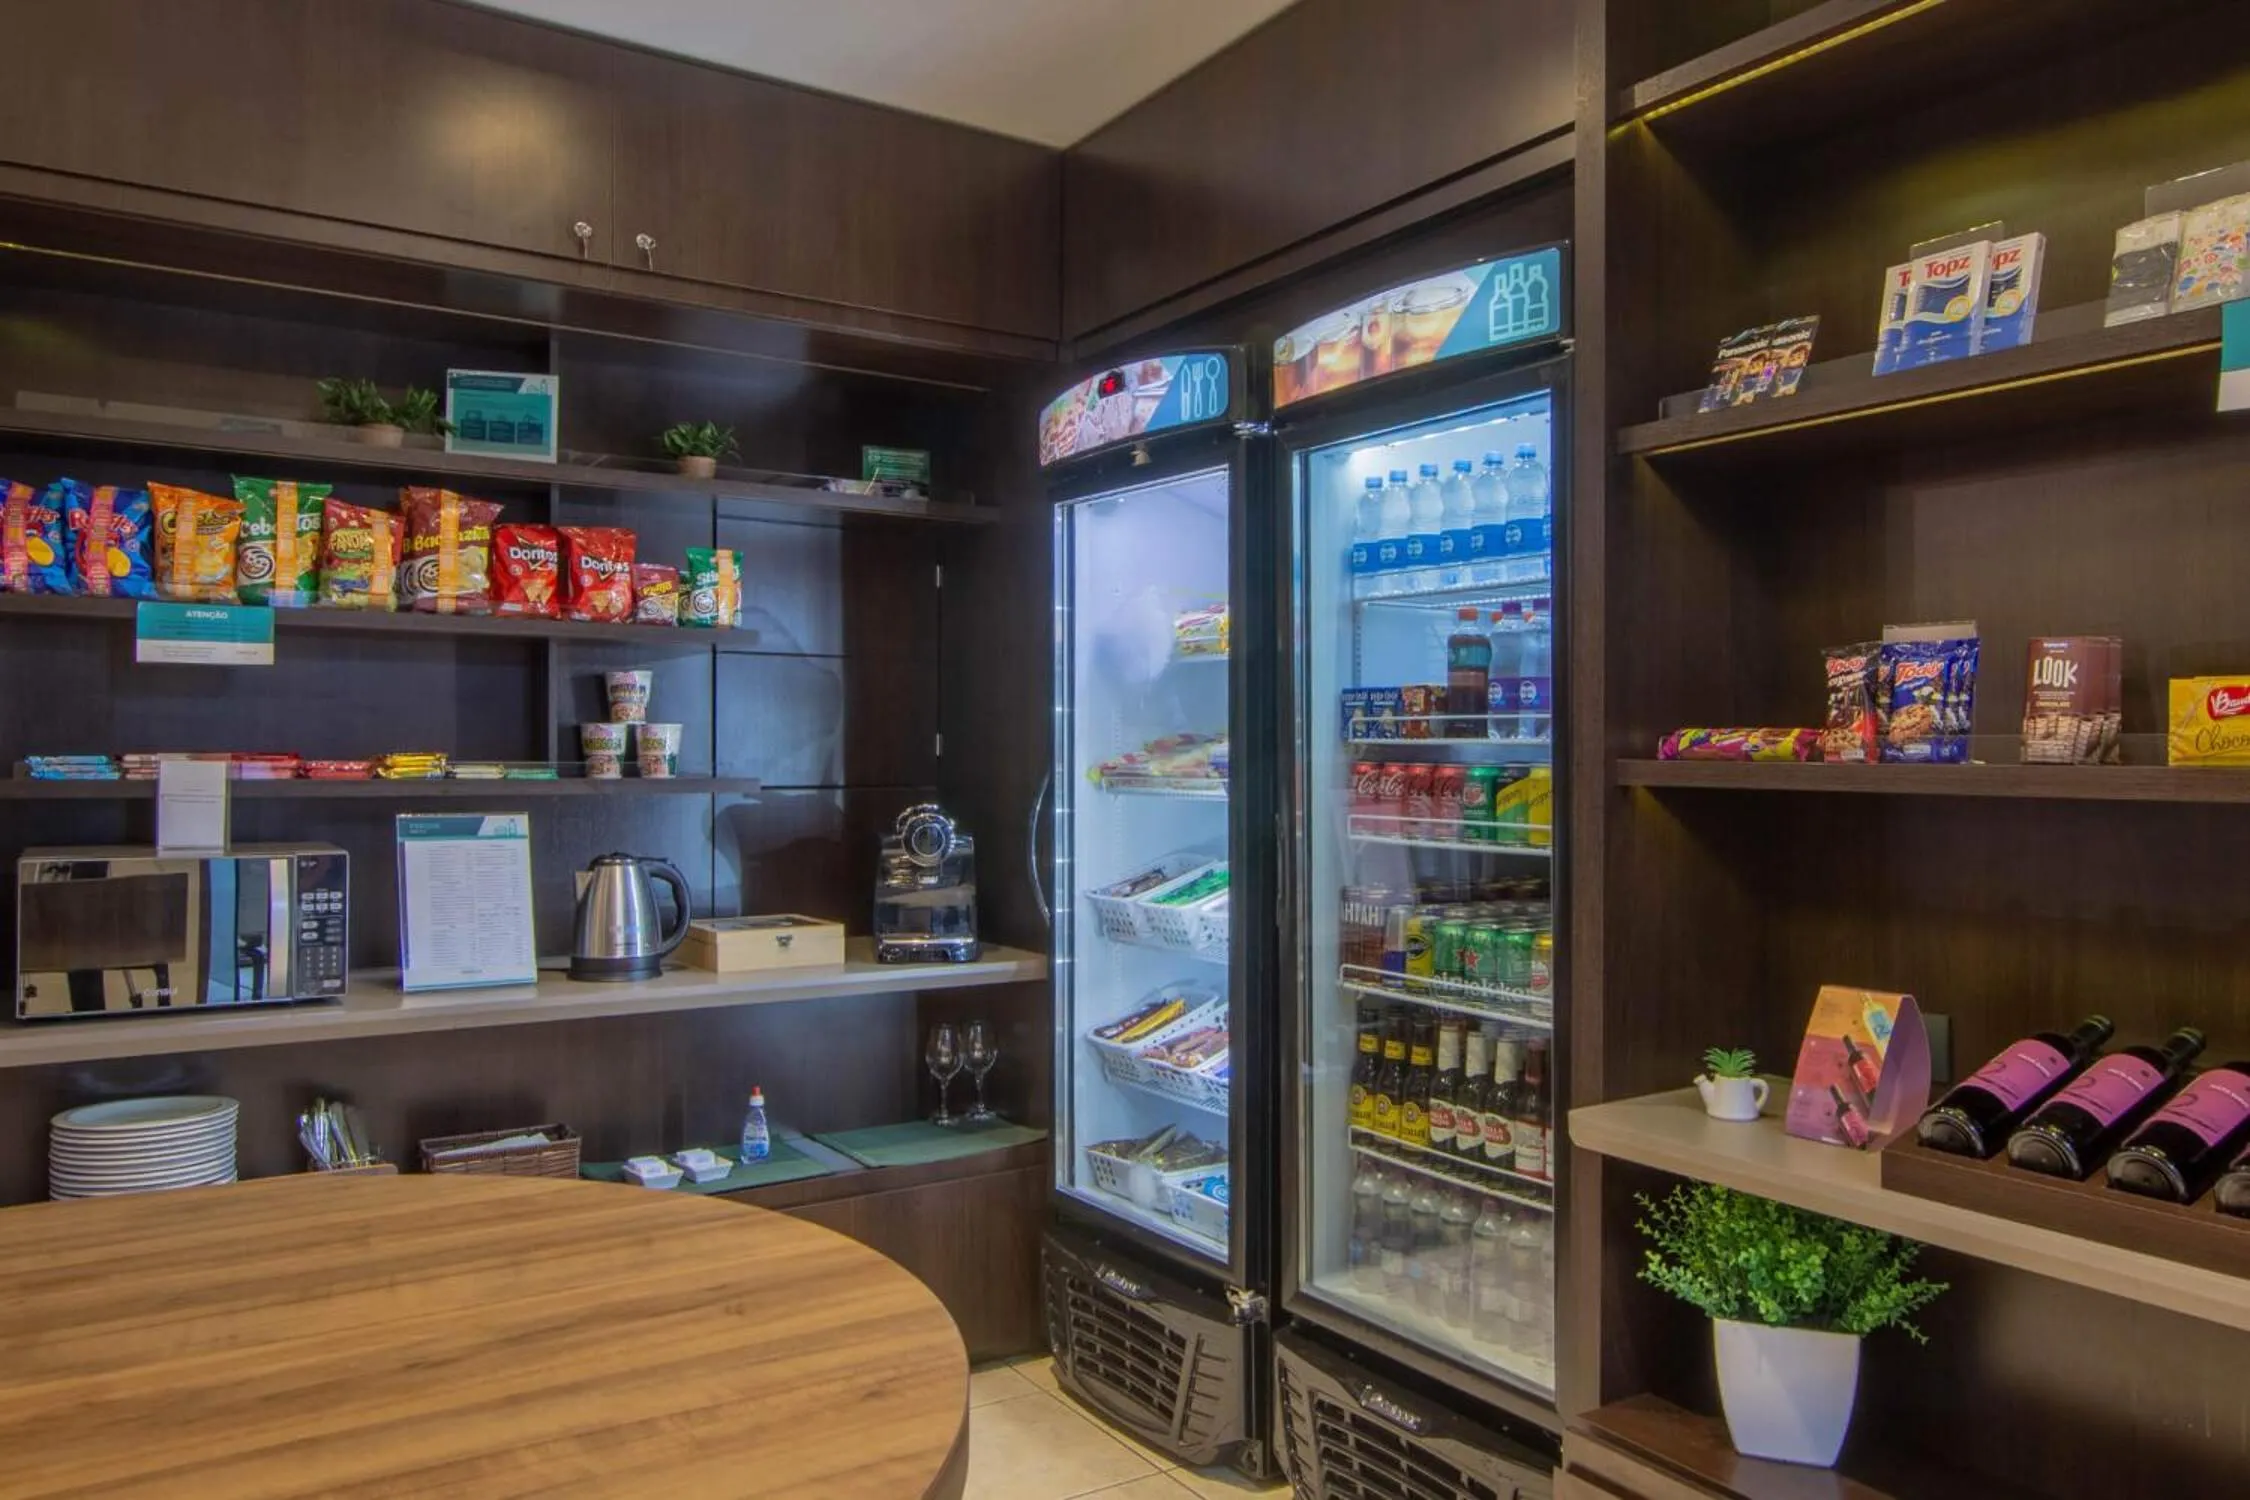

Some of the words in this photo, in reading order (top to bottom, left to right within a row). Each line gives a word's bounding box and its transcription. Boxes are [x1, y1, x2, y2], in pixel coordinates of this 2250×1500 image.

[1925, 256, 1971, 278] Topz
[581, 556, 629, 573] Doritos
[186, 609, 228, 621] ATENÇÃO
[2033, 656, 2078, 688] LOOK
